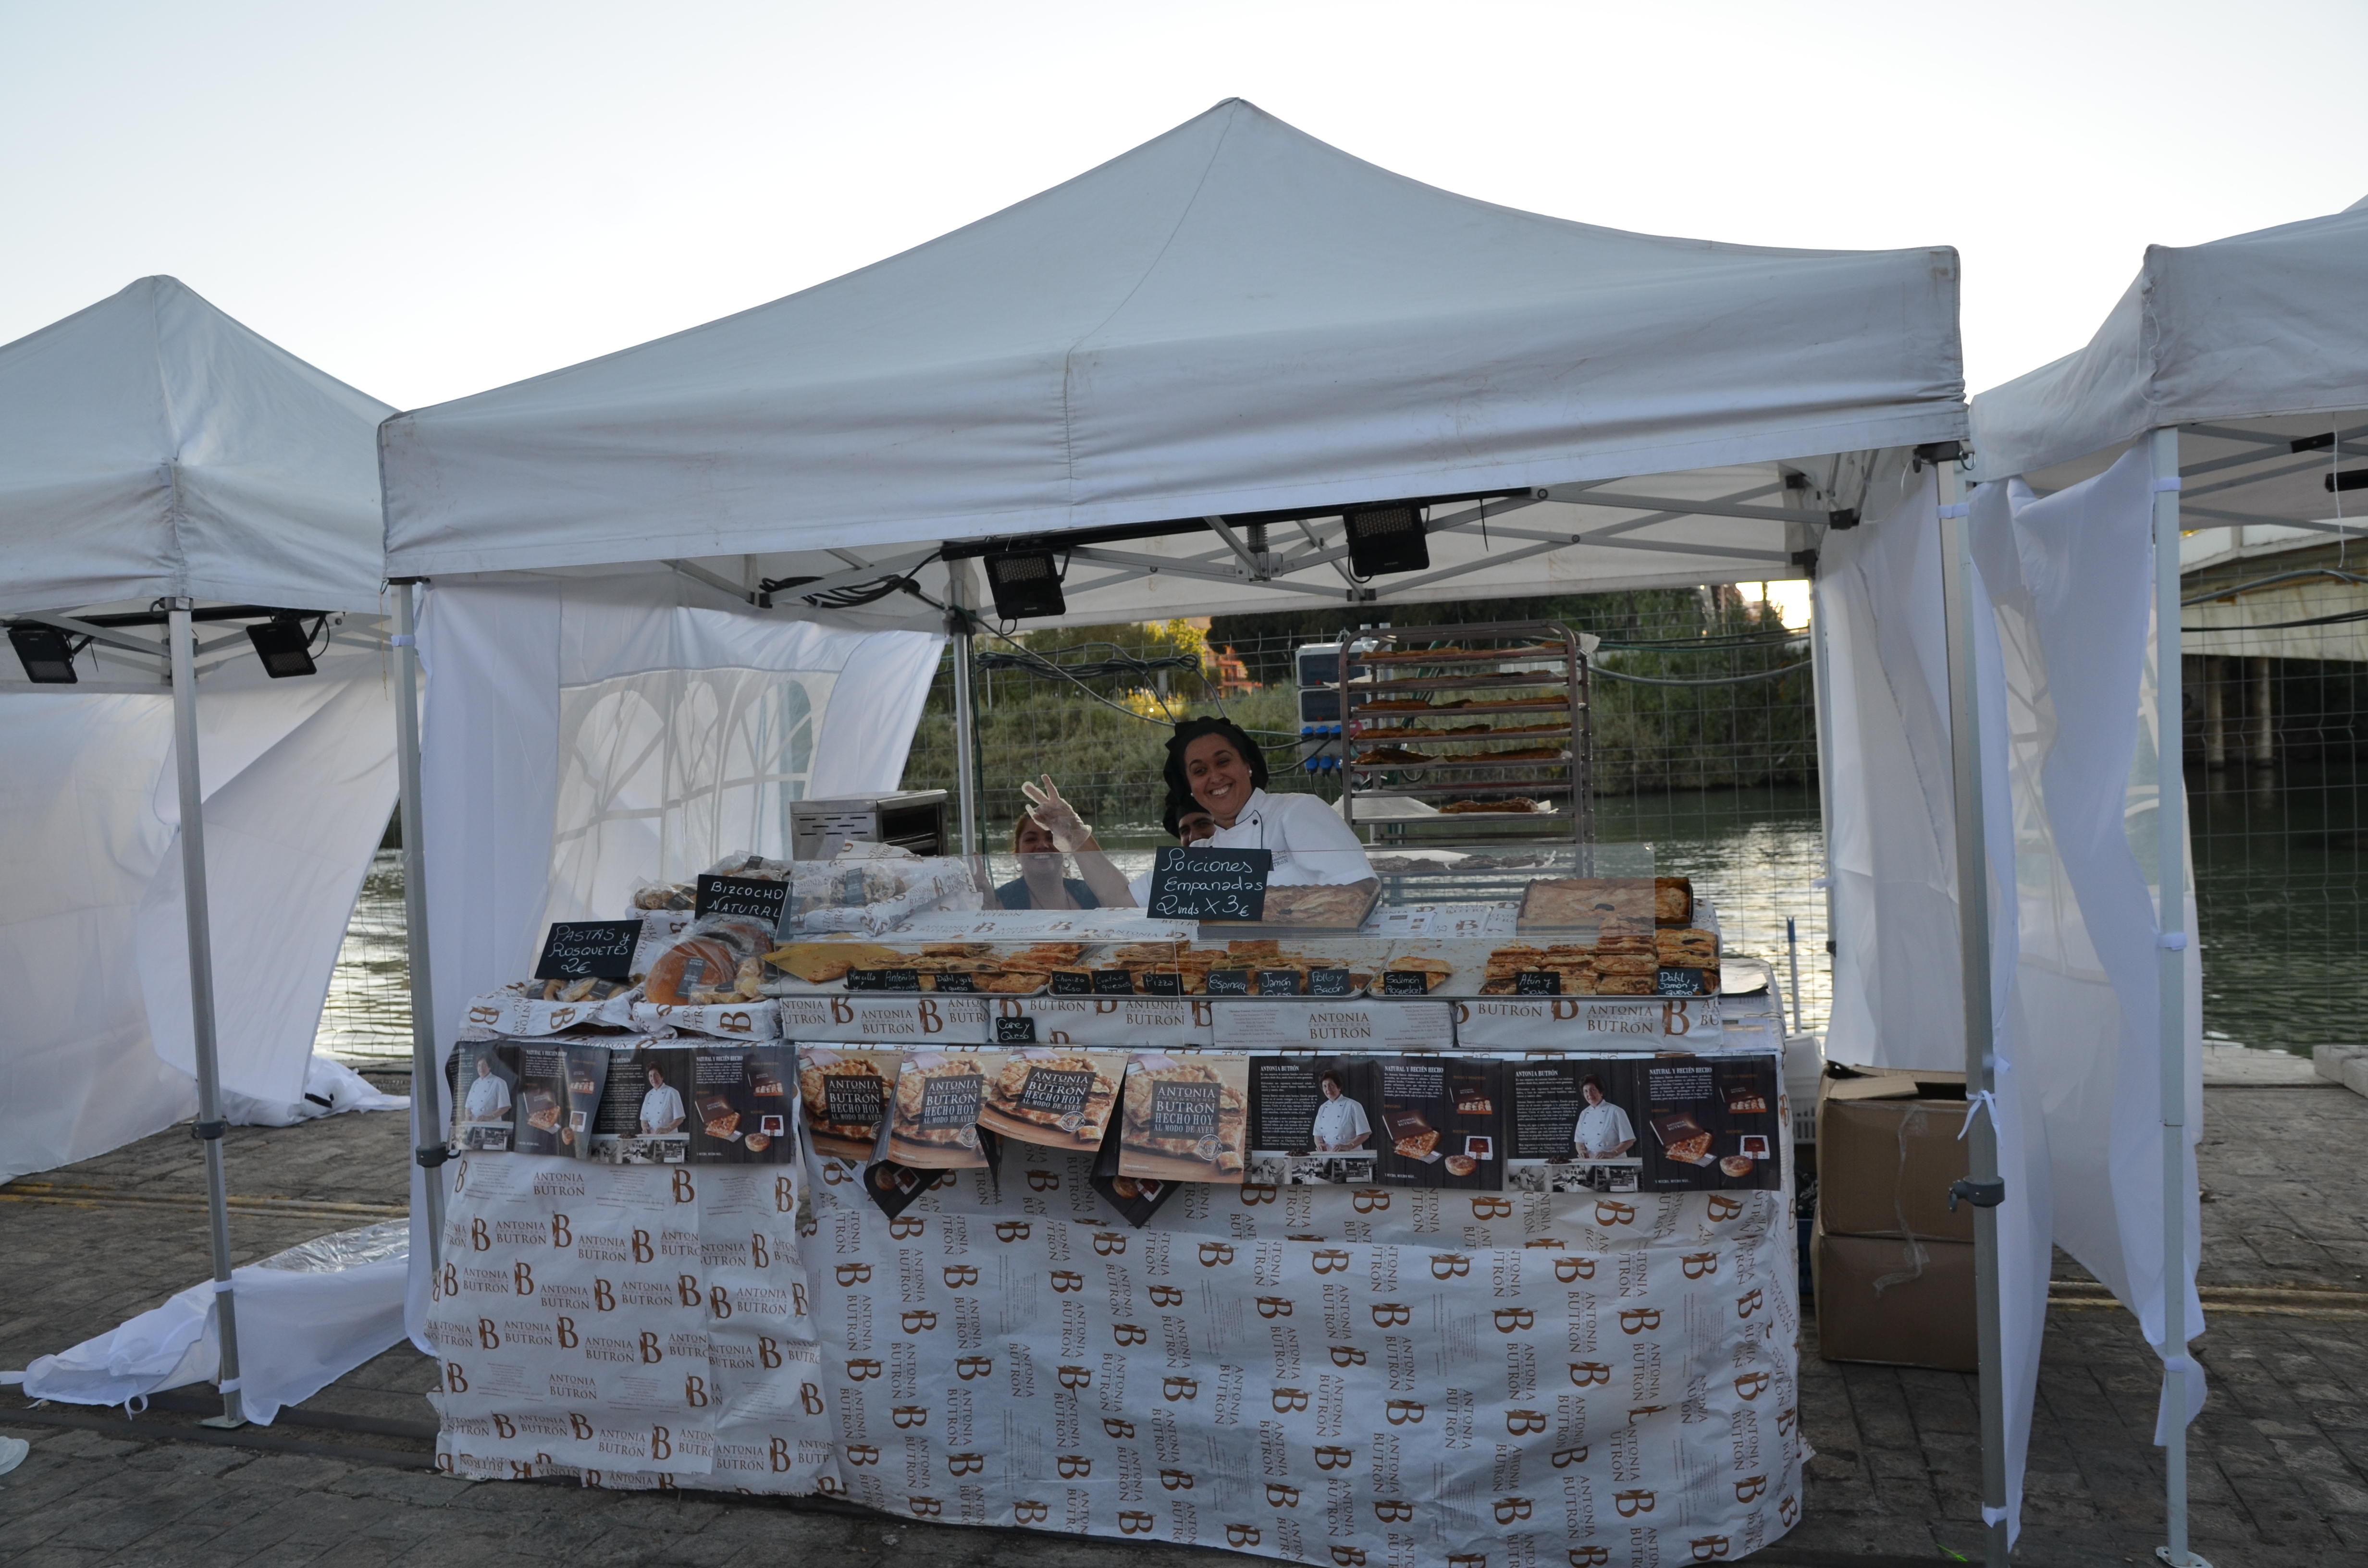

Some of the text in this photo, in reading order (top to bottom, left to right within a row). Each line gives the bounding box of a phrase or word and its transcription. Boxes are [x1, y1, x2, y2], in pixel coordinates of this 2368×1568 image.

[1161, 848, 1252, 873] Porciones
[1164, 876, 1263, 895] Empanadas
[707, 896, 779, 917] NATURAL
[554, 925, 630, 945] PASTAS y
[548, 943, 628, 957] ROSQUETES
[561, 958, 591, 973] 2€
[885, 970, 915, 987] Antoñita
[1096, 975, 1123, 984] Cuatro
[1146, 975, 1173, 987] Pizza
[1262, 972, 1291, 987] Jamón
[1386, 974, 1419, 984] Salmón
[1519, 974, 1553, 988] Atún y
[1102, 981, 1131, 992] quesos
[1314, 983, 1344, 994] Bacón
[1692, 983, 1699, 992] y
[782, 1001, 825, 1009] NTONIA
[1030, 1000, 1085, 1012] BUTRÓN
[1126, 1000, 1183, 1009] ANTONIA
[1479, 1004, 1542, 1017] BUTRÓN
[861, 1010, 912, 1018] ANTONIA
[1588, 1005, 1653, 1017] ANTONIA
[785, 1014, 826, 1024] UTRÓN
[1127, 1014, 1184, 1025] BUTRÓN
[1309, 1013, 1369, 1022] ANTONIA
[863, 1024, 914, 1033] BUTRÓN
[1023, 1024, 1030, 1035] y
[1588, 1020, 1652, 1033] BUTRÓN
[1001, 1031, 1029, 1040] Queso
[1310, 1028, 1370, 1039] BUTRÓN
[1034, 1071, 1088, 1084] ANTONIA
[829, 1080, 878, 1089] ANTONIA
[929, 1080, 978, 1091] ANTONIA
[1028, 1081, 1086, 1096] BUTRÓN
[830, 1093, 880, 1103] BUTRÓN
[1024, 1090, 1083, 1104] HECHO HOY
[1158, 1087, 1216, 1098] ANTONIA
[926, 1093, 977, 1105] BUTRÓN
[830, 1104, 880, 1114] HECHO HOY
[925, 1104, 975, 1116] HECHO HOY
[1156, 1101, 1215, 1114] BUTRÓN
[1155, 1113, 1213, 1126] HECHO HOY
[1165, 1124, 1183, 1132] MODO
[534, 1172, 583, 1182] ANTONIA
[534, 1186, 584, 1196] BUTRÓN
[579, 1236, 625, 1247] ANTONIA
[579, 1249, 626, 1261] BUTRÓN
[622, 1281, 671, 1291] ANTONIA
[622, 1294, 672, 1305] BUTRÓN
[505, 1321, 551, 1332] ANTONIA
[847, 1295, 857, 1350] BUTRÓN
[863, 1295, 871, 1350] ANTONIA
[954, 1298, 968, 1348] BUTRÓN
[968, 1298, 981, 1348] ANTONIA
[506, 1333, 552, 1345] BUTRÓN
[1385, 1336, 1400, 1390] BUTRÓN
[1402, 1337, 1415, 1391] ANTONIA
[1507, 1343, 1520, 1400] BUTRÓN
[1525, 1344, 1536, 1400] ANTONIA
[1633, 1344, 1645, 1400] BUTRÓN
[1649, 1343, 1660, 1398] ANTONIA
[600, 1429, 645, 1442] ANTONIA
[1152, 1409, 1167, 1462] BUTRÓN
[1165, 1410, 1180, 1463] ANTONIA
[599, 1442, 644, 1457] BUTRÓN
